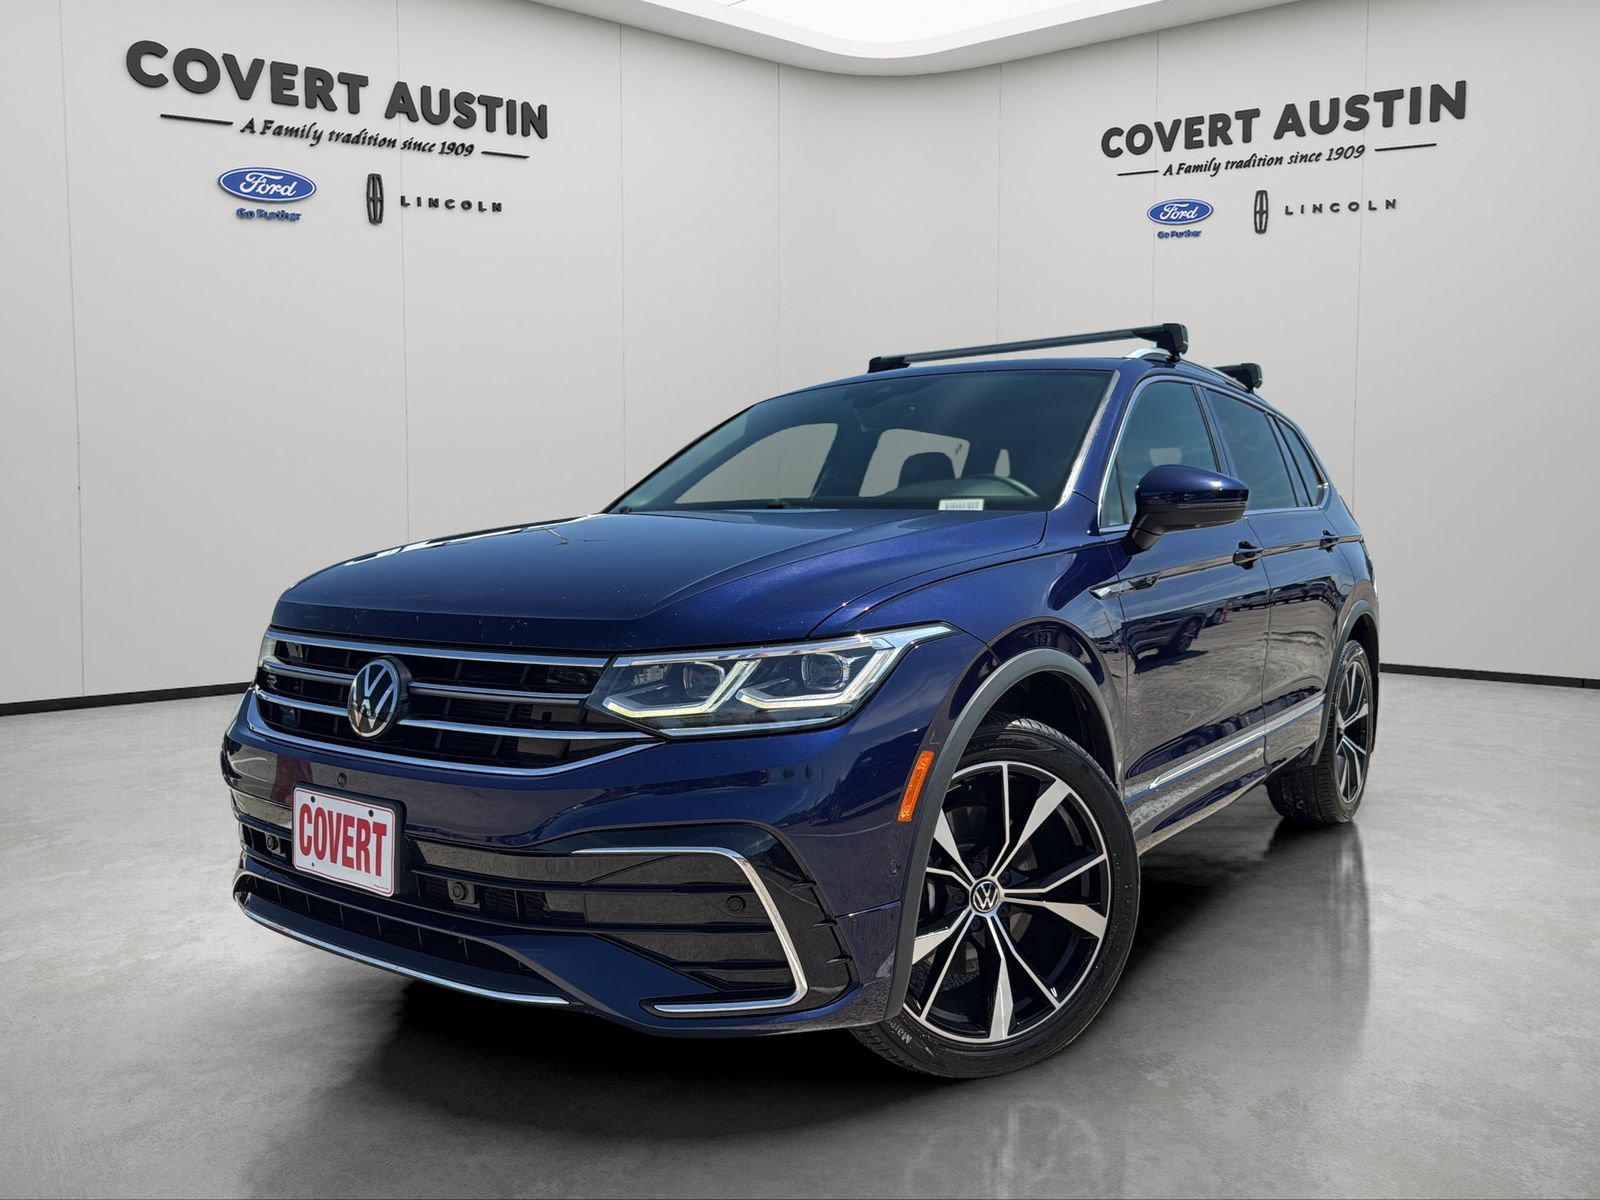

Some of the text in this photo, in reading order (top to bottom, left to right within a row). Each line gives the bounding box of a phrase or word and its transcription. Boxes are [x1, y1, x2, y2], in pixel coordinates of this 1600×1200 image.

[126, 40, 549, 140] COVERT AUSTIN
[1100, 80, 1467, 159] COVERT AUSTIN
[239, 117, 475, 157] A Family tradition since 1909
[1162, 144, 1366, 178] A Family tradition since 1909
[239, 171, 298, 197] Ford
[236, 207, 255, 219] Go
[400, 195, 503, 213] LINCOLN
[1159, 203, 1199, 220] Ford
[1284, 198, 1397, 216] LINCOLN
[1157, 228, 1202, 239] Go Further
[299, 803, 387, 876] COVERT
